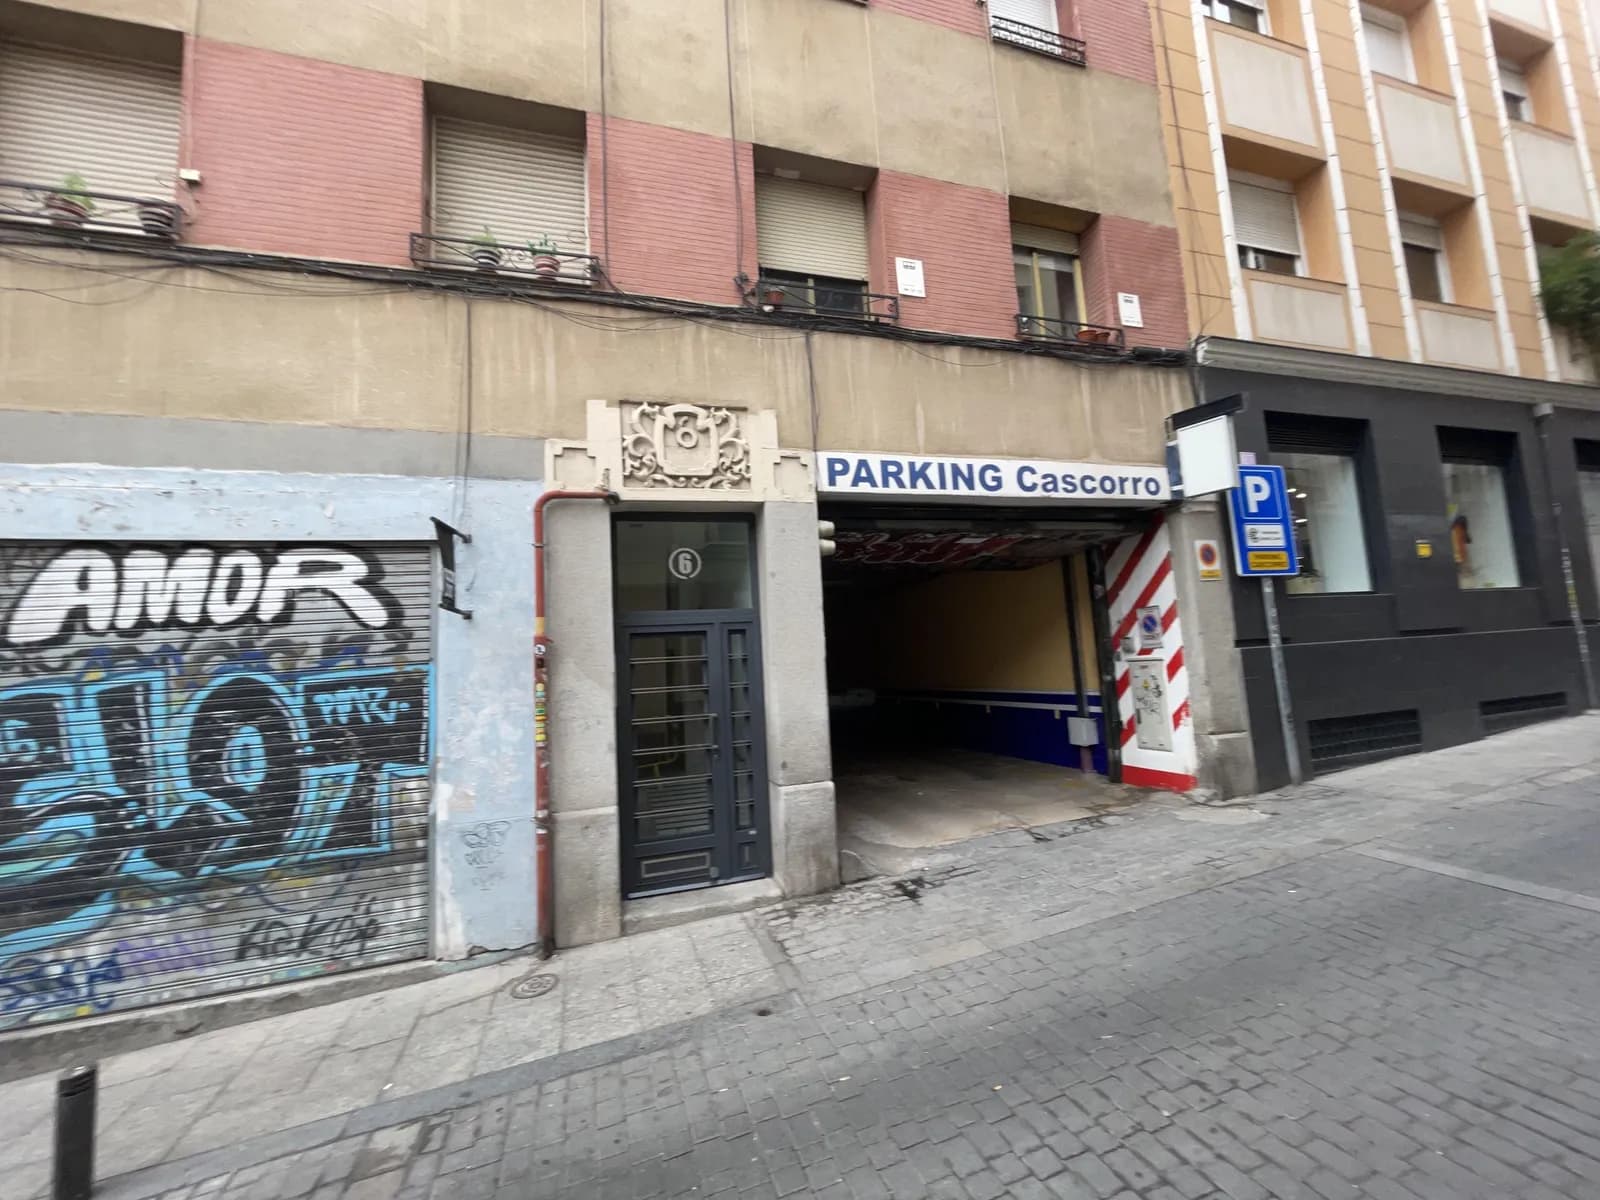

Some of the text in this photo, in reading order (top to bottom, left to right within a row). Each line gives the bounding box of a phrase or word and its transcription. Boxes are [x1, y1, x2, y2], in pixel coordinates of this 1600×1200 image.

[826, 457, 1161, 497] PARKING Cascorro
[1244, 475, 1271, 513] P
[677, 552, 694, 575] 6
[7, 547, 390, 645] AMOR
